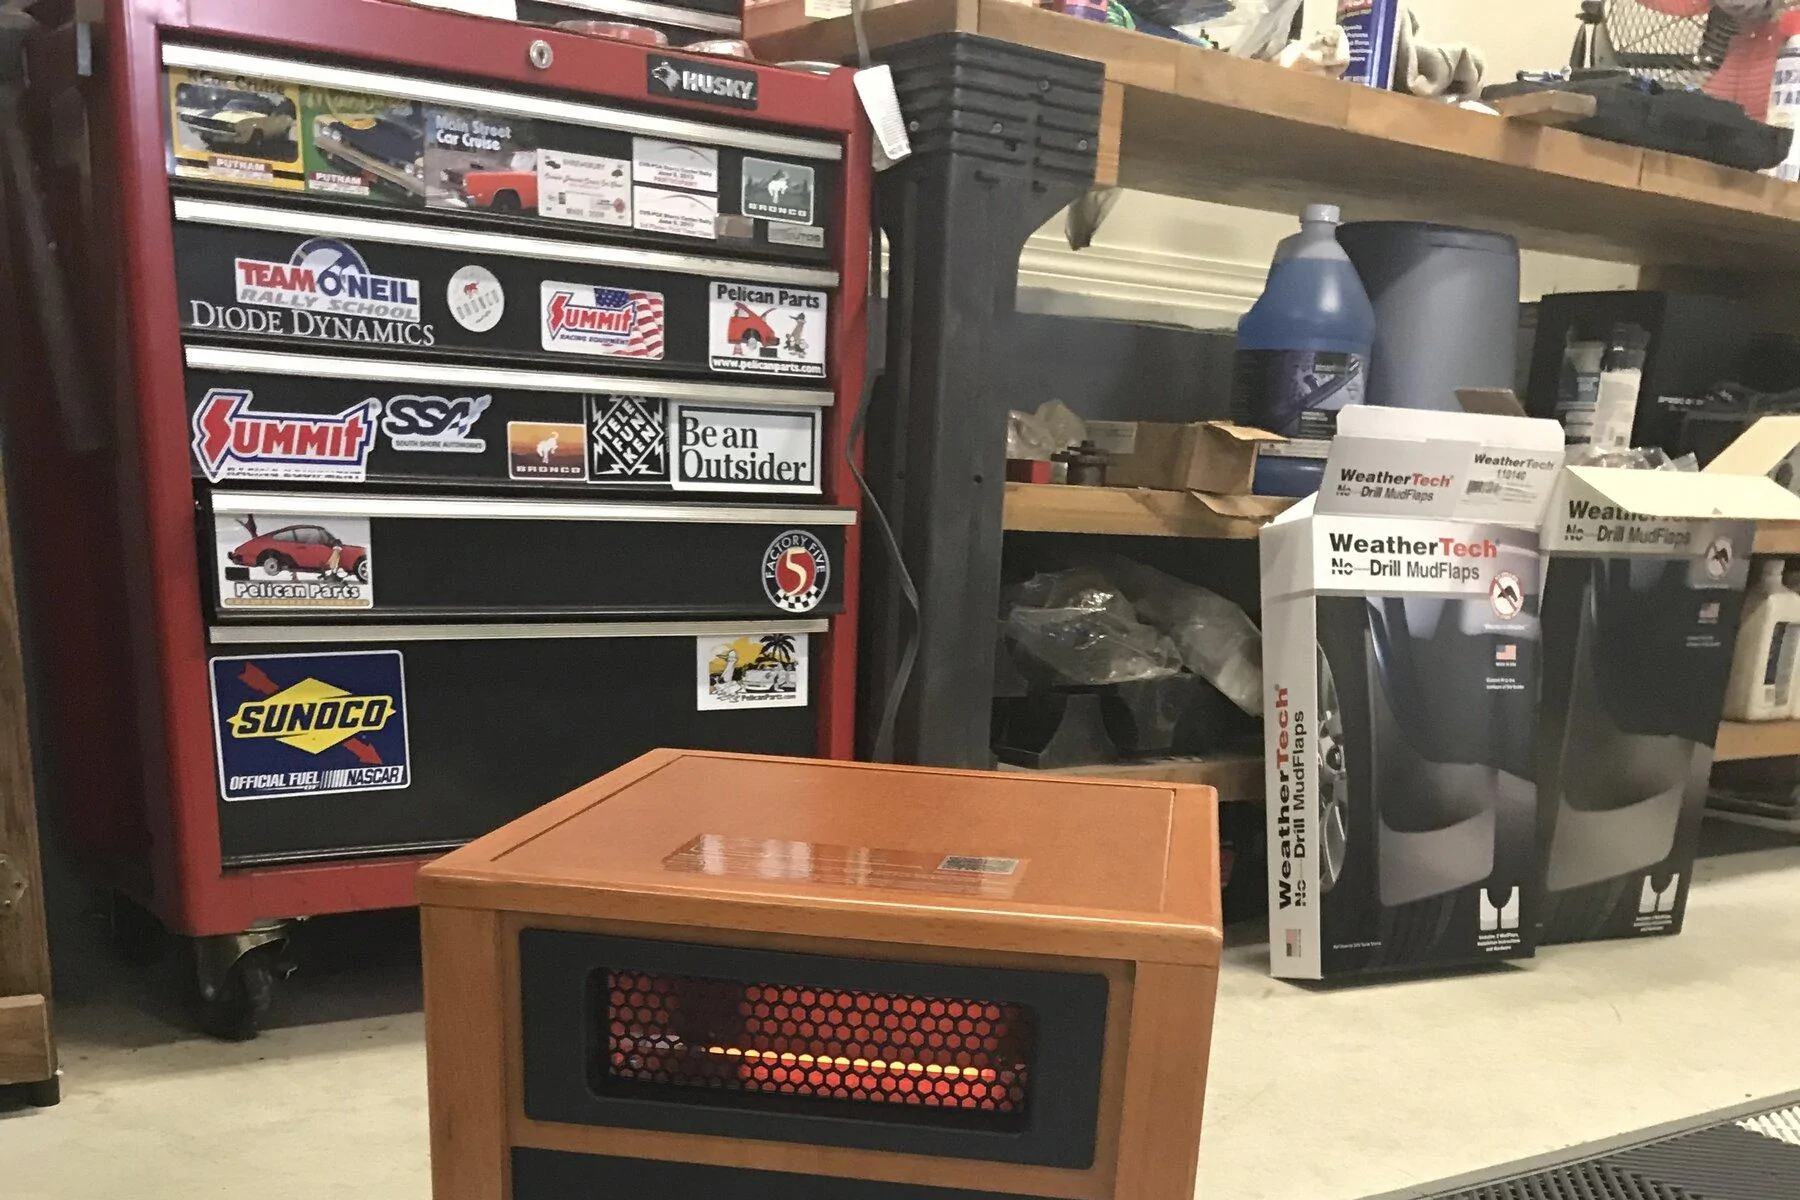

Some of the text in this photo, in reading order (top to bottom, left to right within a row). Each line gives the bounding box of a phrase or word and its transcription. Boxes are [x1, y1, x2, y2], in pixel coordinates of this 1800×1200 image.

[682, 70, 754, 100] HUSKY
[436, 129, 501, 151] Car Cruise
[748, 203, 807, 217] BRONCO
[238, 261, 317, 293] TEAM
[240, 288, 418, 320] RALLY SCHOOL
[717, 284, 820, 309] Pelican Parts
[190, 300, 435, 347] DIODE DYNAMICS
[712, 358, 823, 375] www.pelicanparts.com
[600, 400, 636, 440] TELE
[612, 413, 646, 452] FUN
[623, 425, 657, 464] KEN
[516, 465, 581, 474] BRONCO
[681, 449, 807, 482] Outsider
[1474, 453, 1554, 471] WeatherTech
[1340, 468, 1453, 488] WeatherTech
[1384, 487, 1434, 503] MudFlaps
[765, 534, 826, 579] FACTORY FIVE
[1329, 533, 1498, 558] WeatherTech
[1406, 561, 1480, 583] MudFlaps
[234, 582, 360, 599] Pelican Parts
[237, 699, 388, 735] SUNOCO
[1292, 710, 1307, 811] MudFlaps
[229, 767, 400, 791] OFFICIAL FUEL NASCAR
[1275, 687, 1293, 910] WeatherTech
